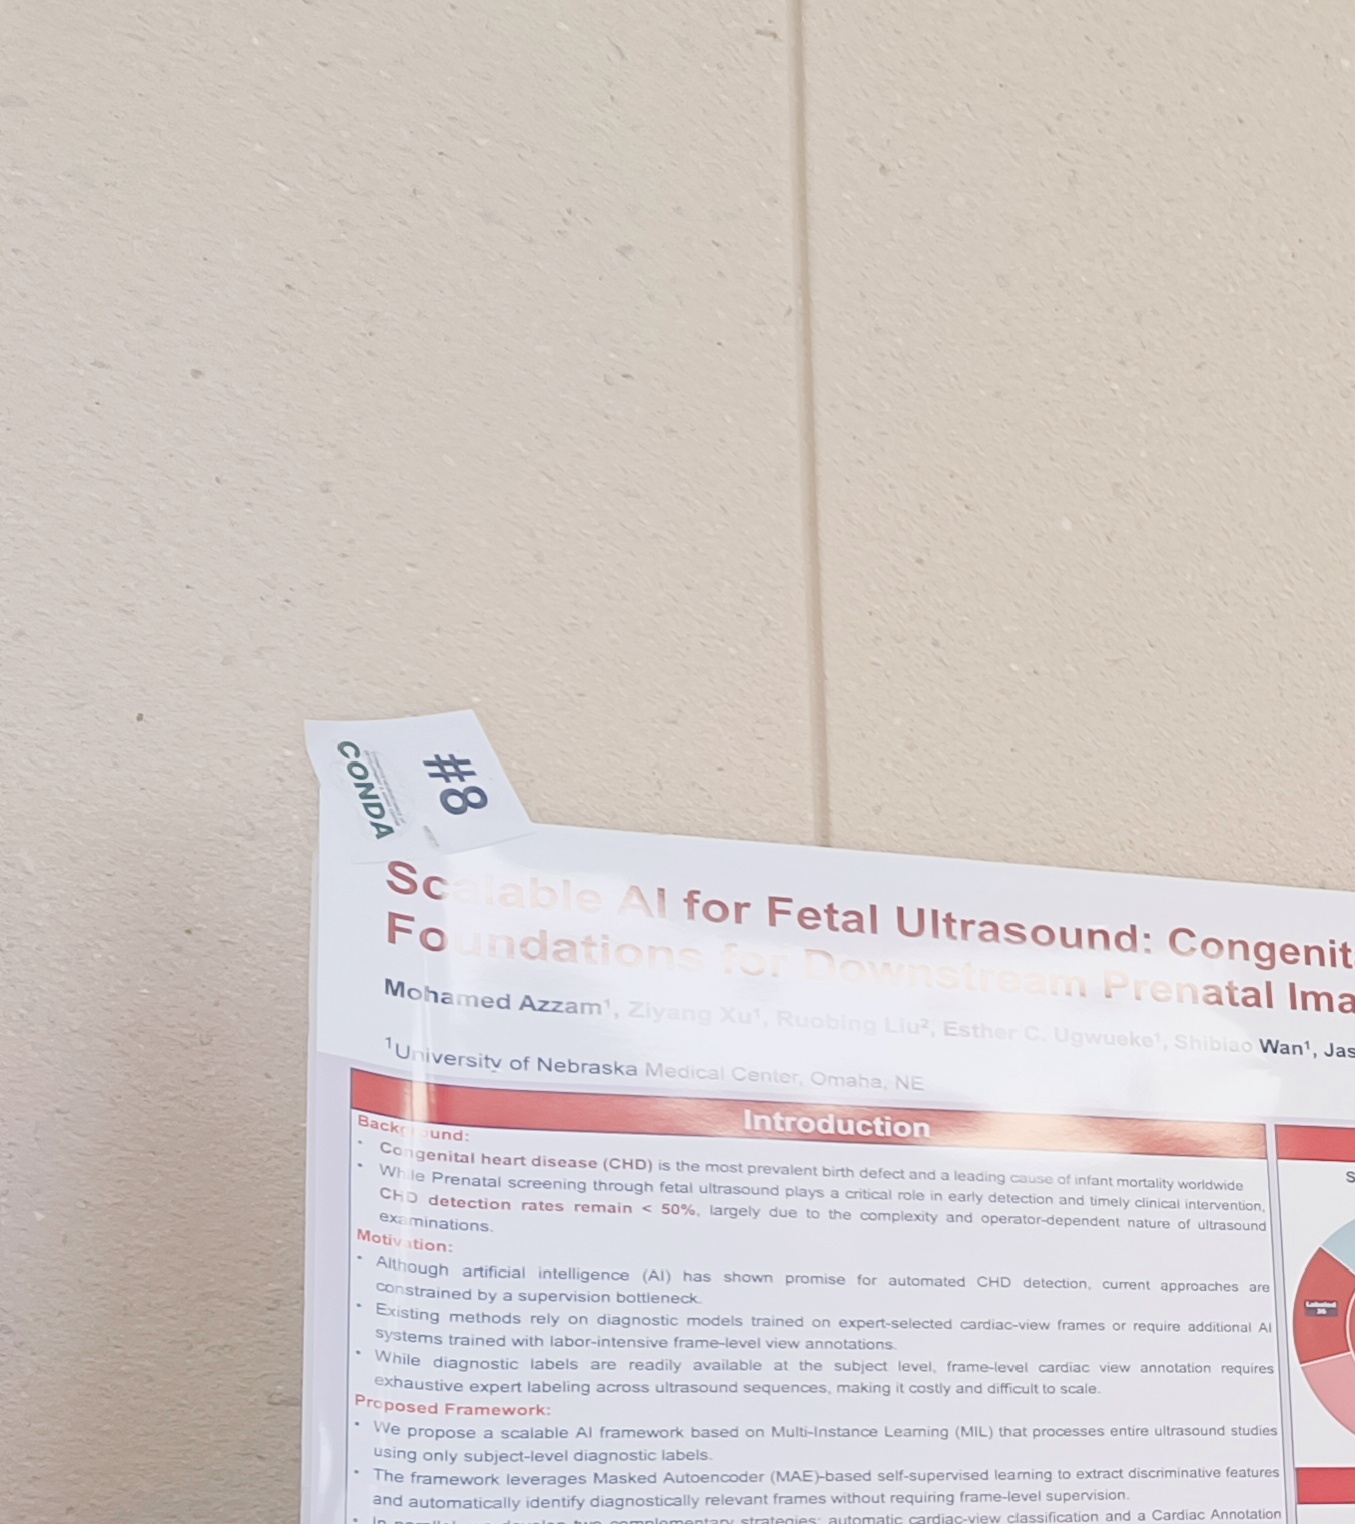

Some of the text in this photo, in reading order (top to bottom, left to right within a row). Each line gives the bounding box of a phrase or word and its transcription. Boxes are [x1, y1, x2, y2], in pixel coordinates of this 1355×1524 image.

[338, 741, 394, 840] CONDA
[423, 754, 488, 815] #8
[386, 860, 602, 914] Scalable
[618, 885, 666, 918] AI
[684, 890, 751, 924] for
[767, 895, 878, 934] Fetal
[896, 906, 1152, 954] Ultrasound:
[387, 911, 701, 973] Foundations
[723, 943, 788, 978] for
[804, 948, 1087, 998] Downstream
[1104, 971, 1274, 1009] Prenatal
[385, 978, 511, 1010] Mohamed
[510, 1055, 529, 1071] of
[537, 1056, 637, 1077] Nebraska
[645, 1062, 724, 1081] Medical
[731, 1066, 803, 1086] Center,
[811, 1071, 887, 1090] Omaha,
[895, 1074, 925, 1091] NE
[743, 1109, 931, 1138] Introduction
[481, 1154, 652, 1172] heart disease (CHD)
[428, 1194, 701, 1217] detection rates remain 50%,
[355, 1394, 551, 1417] Proposed Framework:
[374, 1446, 713, 1464] using only subject-level diagnostic labels.
